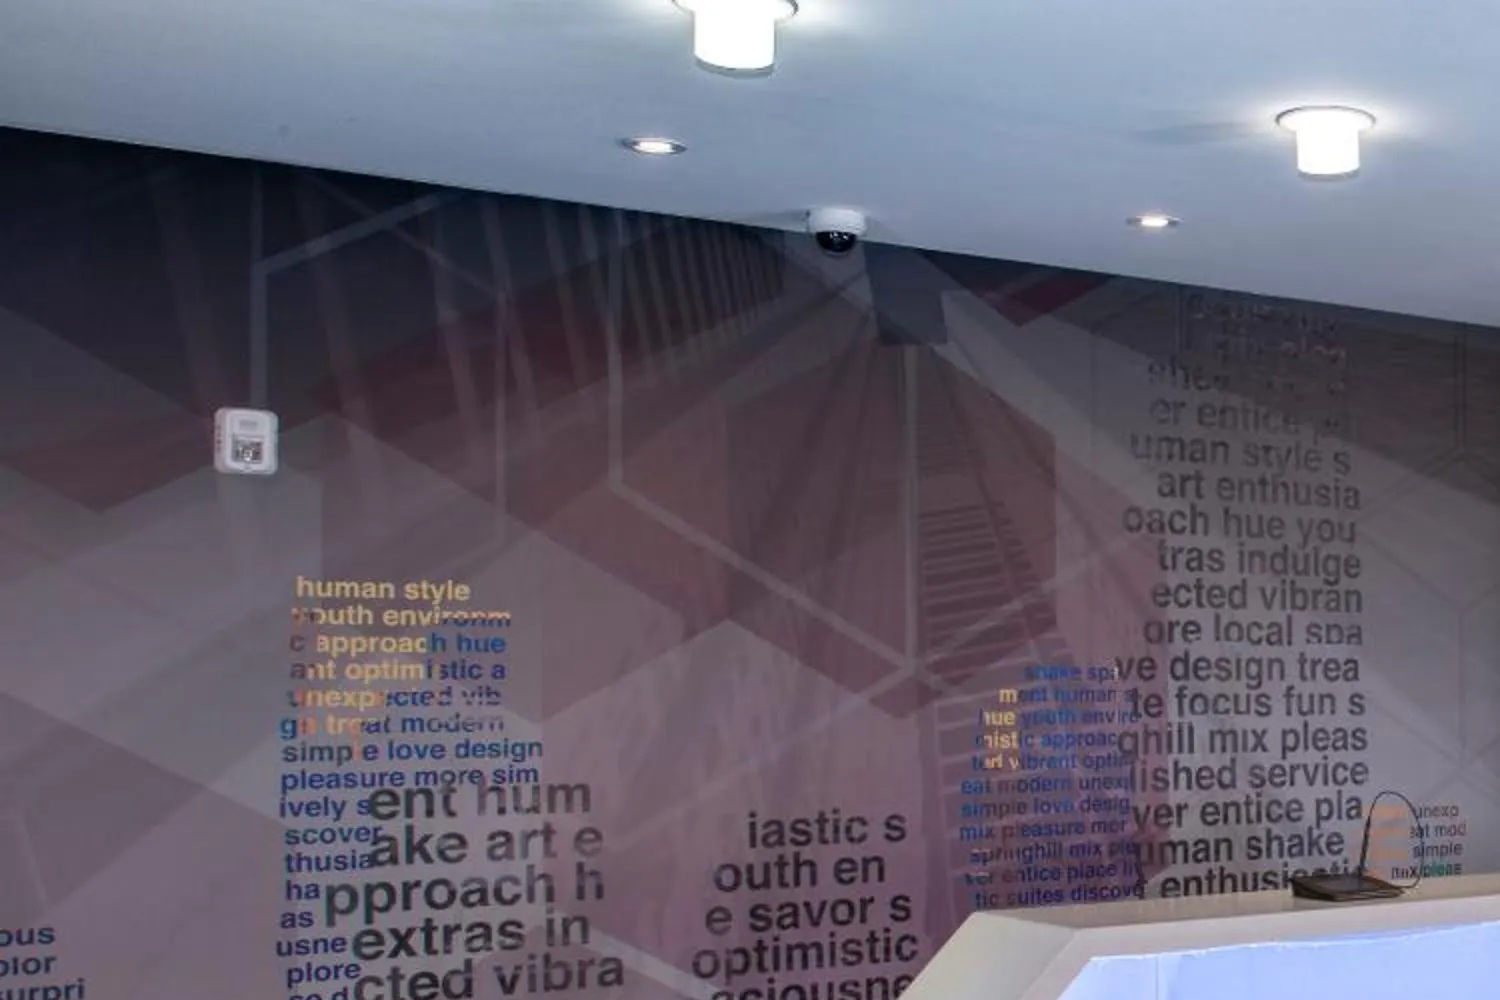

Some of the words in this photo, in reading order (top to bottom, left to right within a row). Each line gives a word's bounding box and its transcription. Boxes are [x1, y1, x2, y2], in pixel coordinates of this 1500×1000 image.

[1130, 433, 1229, 465] uman
[1243, 440, 1323, 478] style
[1157, 469, 1205, 499] art
[1216, 472, 1360, 510] enthusia
[1122, 502, 1210, 536] oach
[1223, 506, 1286, 540] hue
[1297, 517, 1357, 548] you
[1157, 539, 1225, 573] tras
[1237, 542, 1361, 587] indulge
[295, 575, 395, 600] human
[404, 579, 471, 604] style
[1151, 577, 1247, 609] ected
[1259, 579, 1363, 613] vibran
[316, 631, 447, 657] approach
[455, 632, 507, 653] hue
[1142, 618, 1201, 645] ore
[1213, 614, 1293, 647] local
[491, 663, 507, 679] a
[1117, 655, 1158, 682] ve
[1169, 649, 1285, 690] design
[1300, 652, 1360, 682] trea
[1175, 685, 1273, 718] focus
[1284, 685, 1336, 717] fun
[1347, 693, 1366, 717] s
[387, 741, 447, 761] love
[455, 738, 543, 764] design
[1208, 727, 1269, 754] mix
[1281, 720, 1368, 759] pleas
[281, 768, 411, 792] pleasure
[415, 768, 484, 787] more
[492, 763, 540, 785] sim
[1129, 757, 1237, 793] lished
[1248, 755, 1370, 789] service
[280, 796, 346, 822] ively
[368, 783, 457, 820] ent
[477, 779, 591, 817] hum
[1033, 798, 1075, 814] love
[1132, 800, 1189, 831] ver
[1200, 791, 1304, 826] entice
[1315, 789, 1363, 829] pla
[284, 824, 384, 846] scover
[369, 823, 471, 864] ake
[485, 821, 558, 860] art
[573, 826, 605, 857] e
[747, 808, 869, 849] iastic
[882, 813, 908, 843] s
[1246, 826, 1345, 859] shake
[286, 879, 320, 901] ha
[712, 851, 818, 893] outh
[833, 854, 886, 886] en
[324, 863, 556, 928] pproach
[575, 861, 605, 901] h
[280, 910, 314, 930] as
[351, 918, 526, 961] extras
[545, 905, 590, 947] in
[704, 905, 733, 936] e
[748, 896, 875, 933] savor
[275, 935, 348, 958] usne
[691, 927, 919, 986] optimistic
[286, 961, 362, 988] plore
[494, 952, 624, 997] vibra
